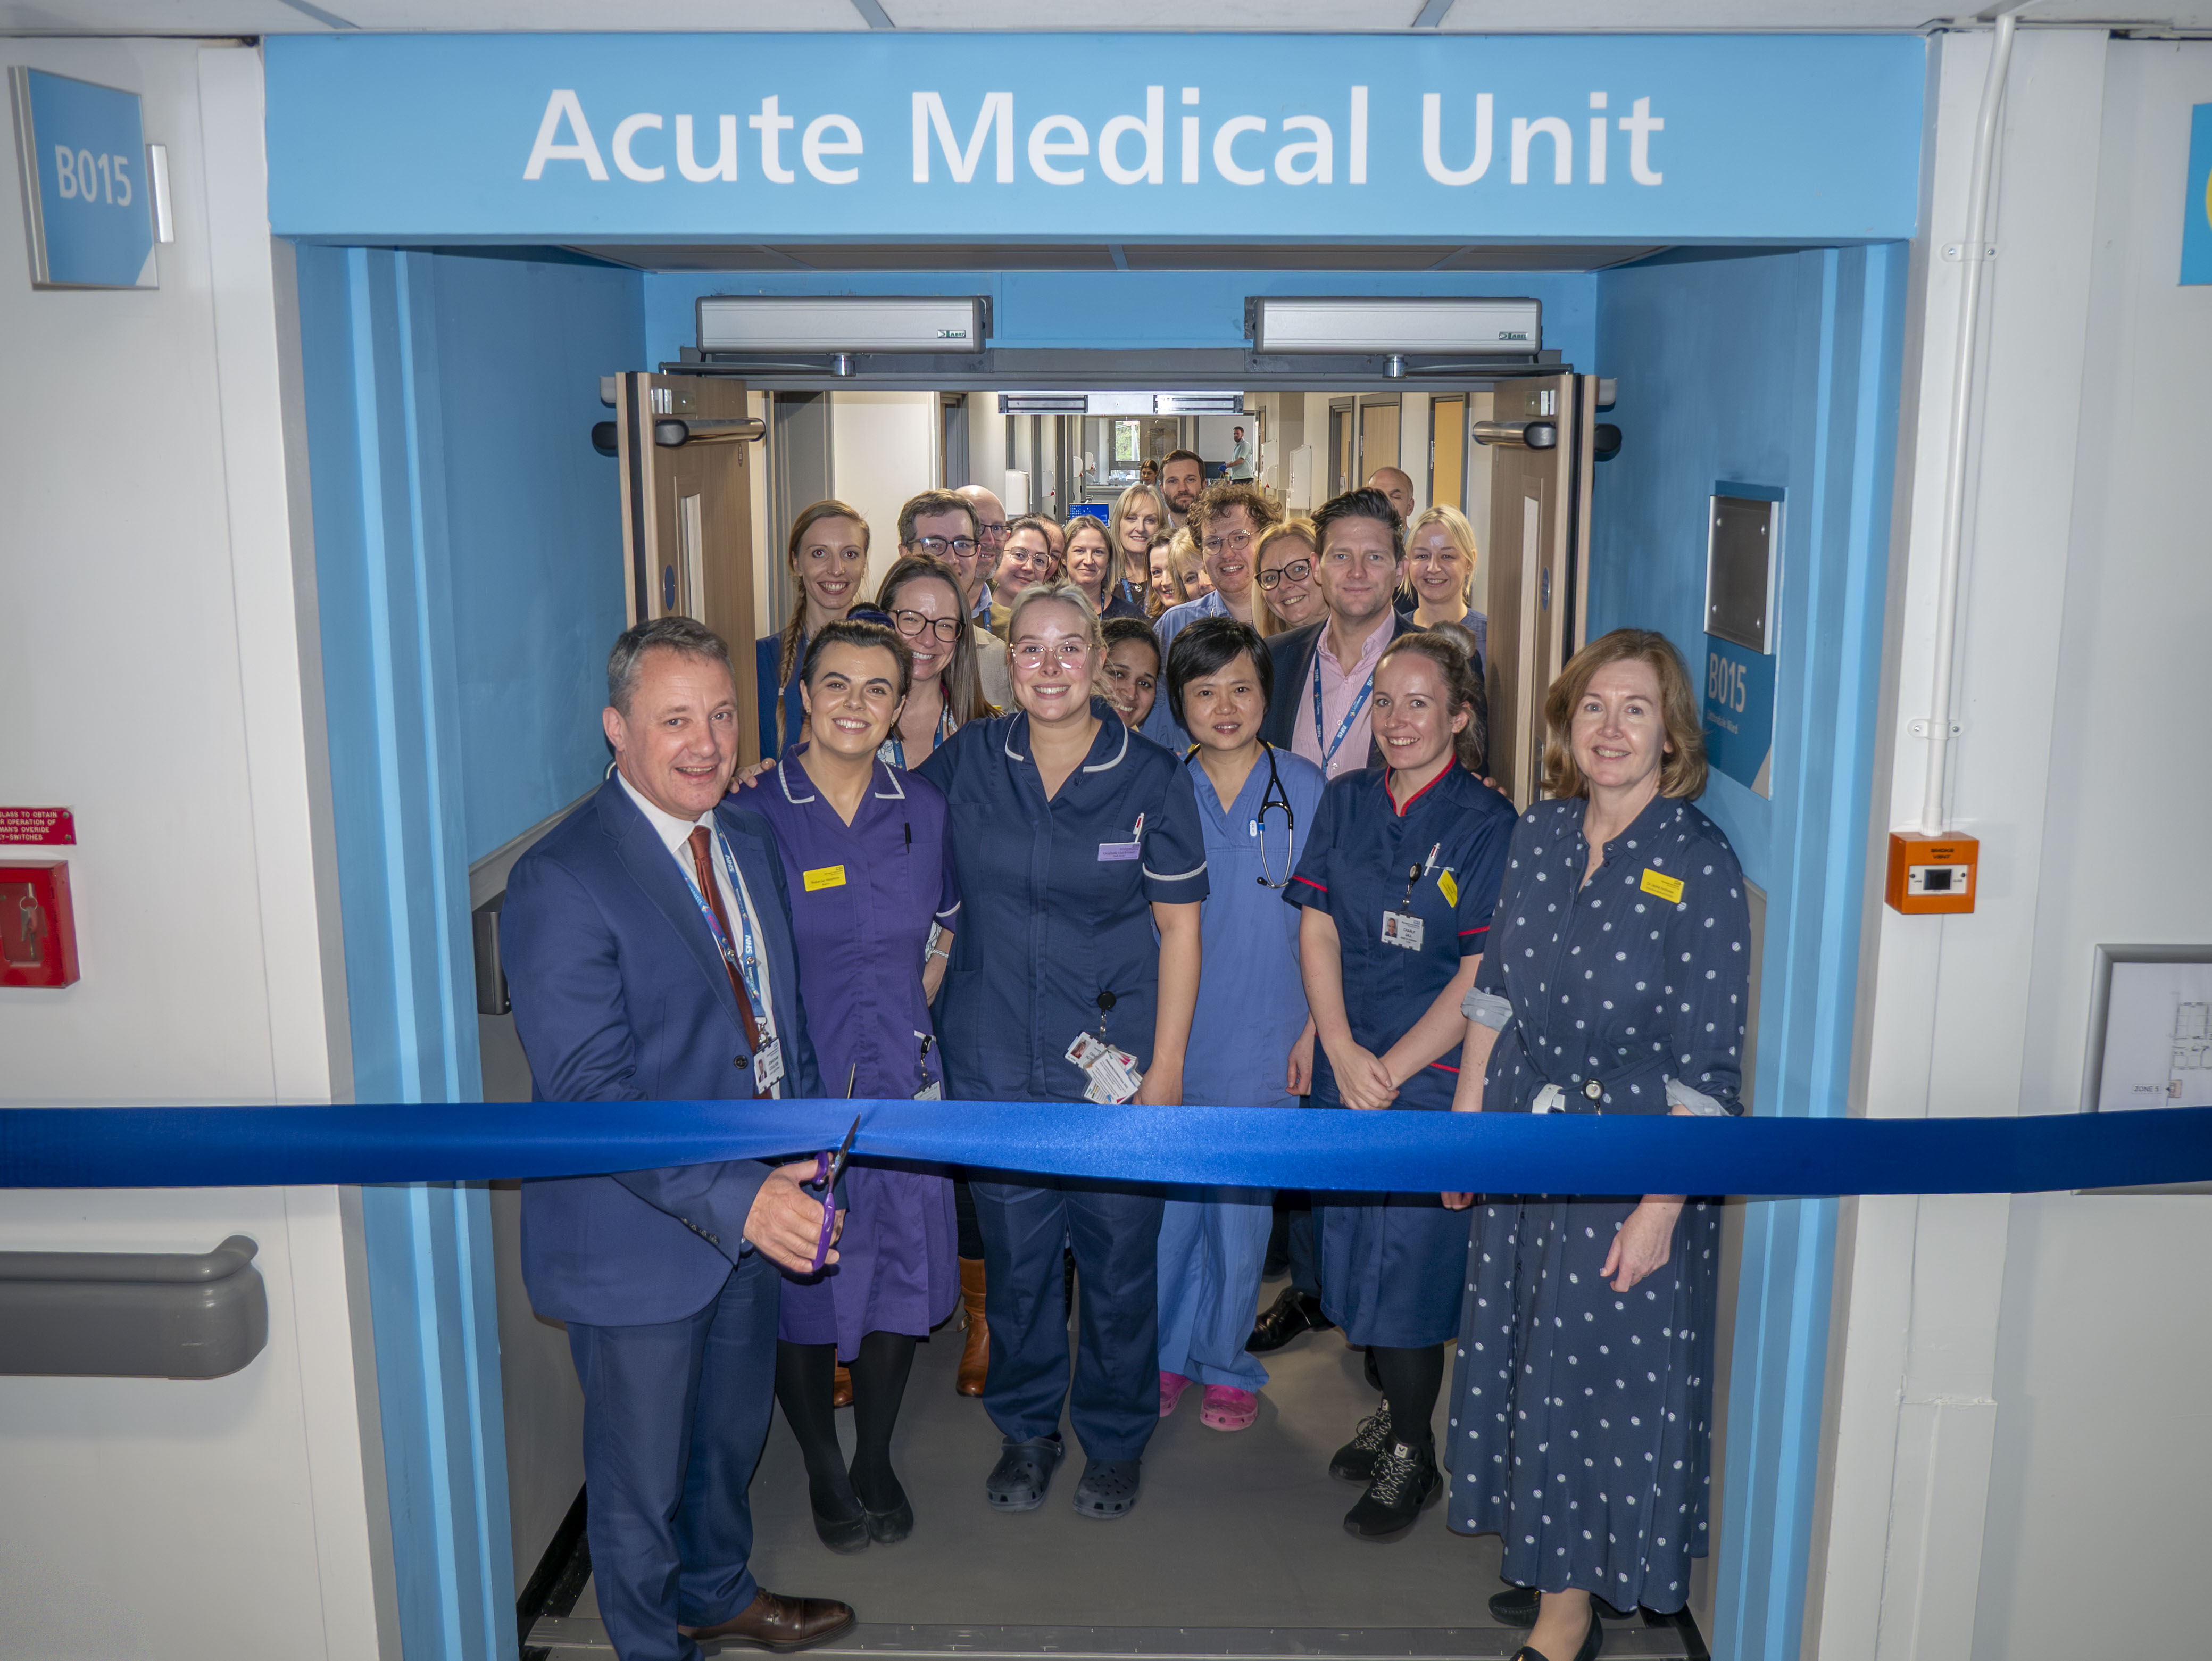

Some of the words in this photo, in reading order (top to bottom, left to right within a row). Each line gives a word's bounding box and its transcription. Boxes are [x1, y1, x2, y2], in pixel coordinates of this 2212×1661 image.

[523, 89, 863, 184] Acute
[912, 85, 1368, 185] Medical
[1422, 91, 1664, 186] Unit
[55, 144, 132, 207] B015
[1708, 652, 1747, 713] B015
[1337, 725, 1347, 739] NHS
[725, 854, 735, 873] NHS
